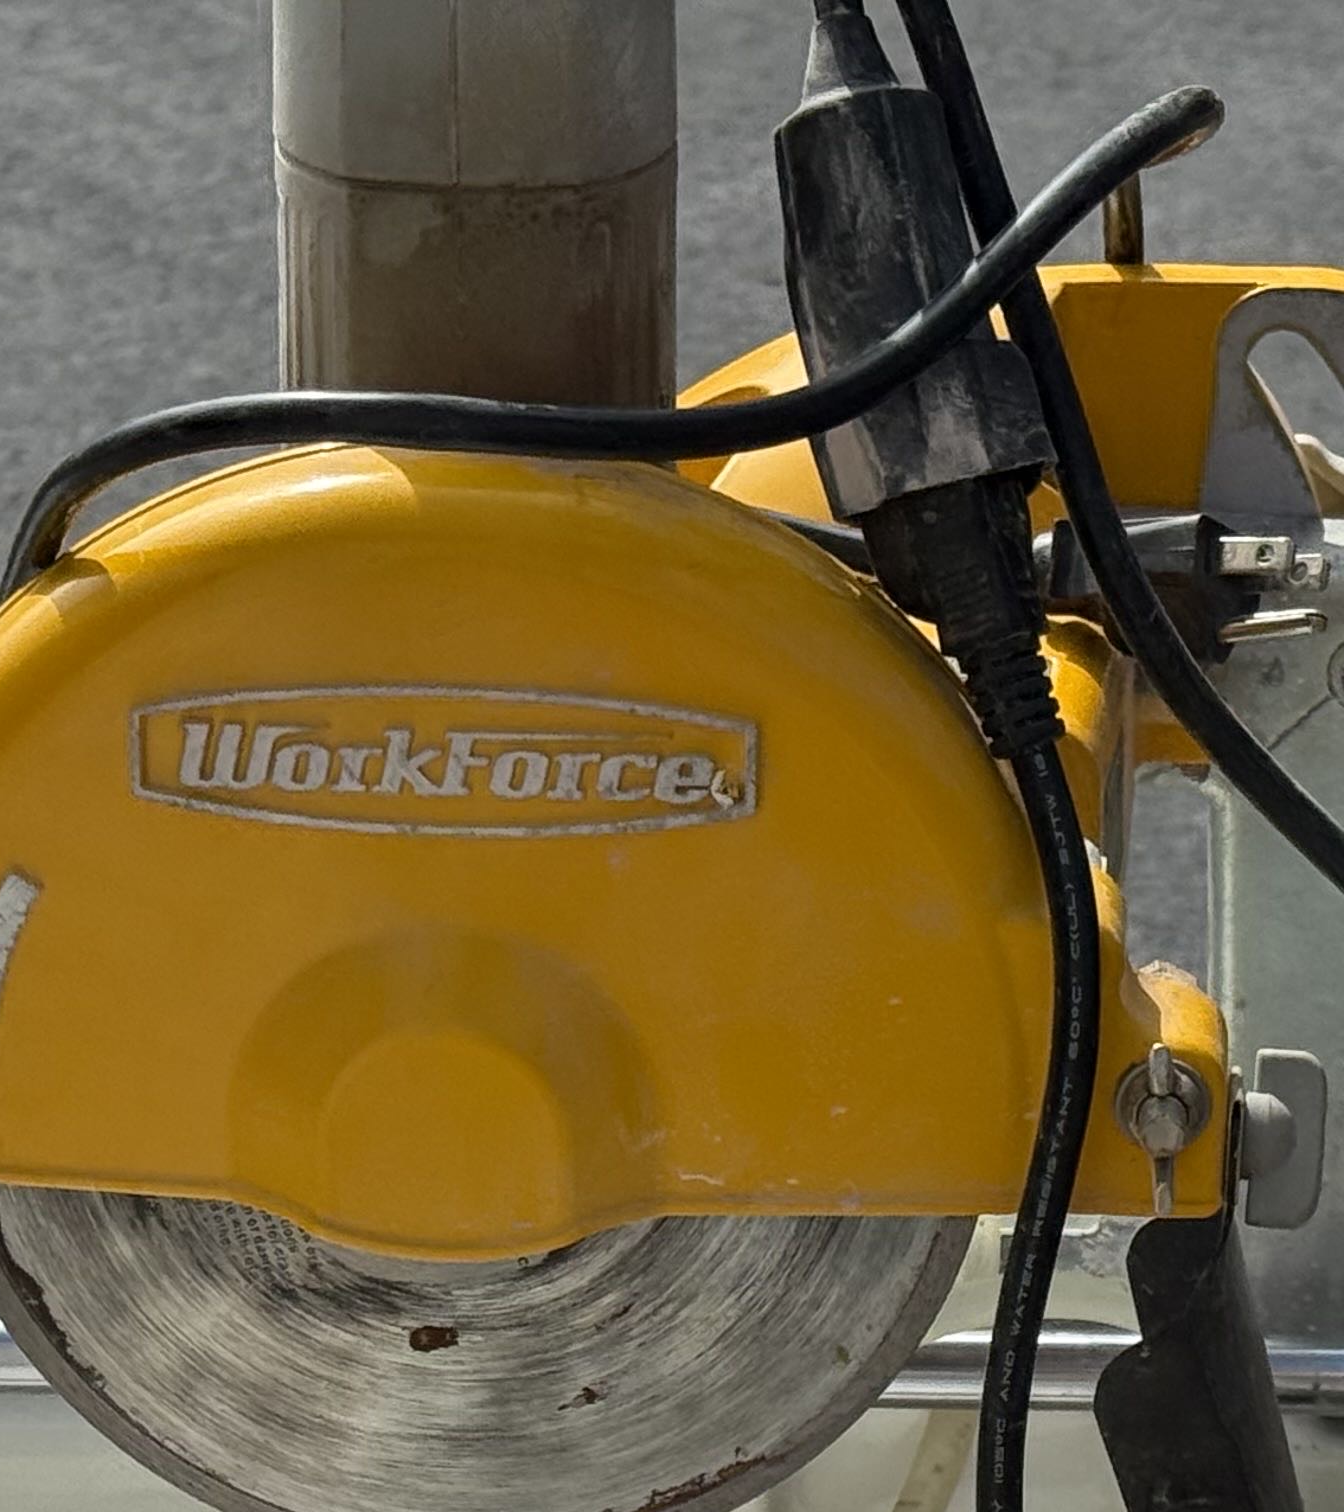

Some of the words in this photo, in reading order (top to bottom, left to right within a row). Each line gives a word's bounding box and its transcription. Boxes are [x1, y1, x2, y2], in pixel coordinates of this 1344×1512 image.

[179, 720, 716, 803] WorkForce
[1007, 1252, 1038, 1338] WATER
[998, 1348, 1017, 1402] AND
